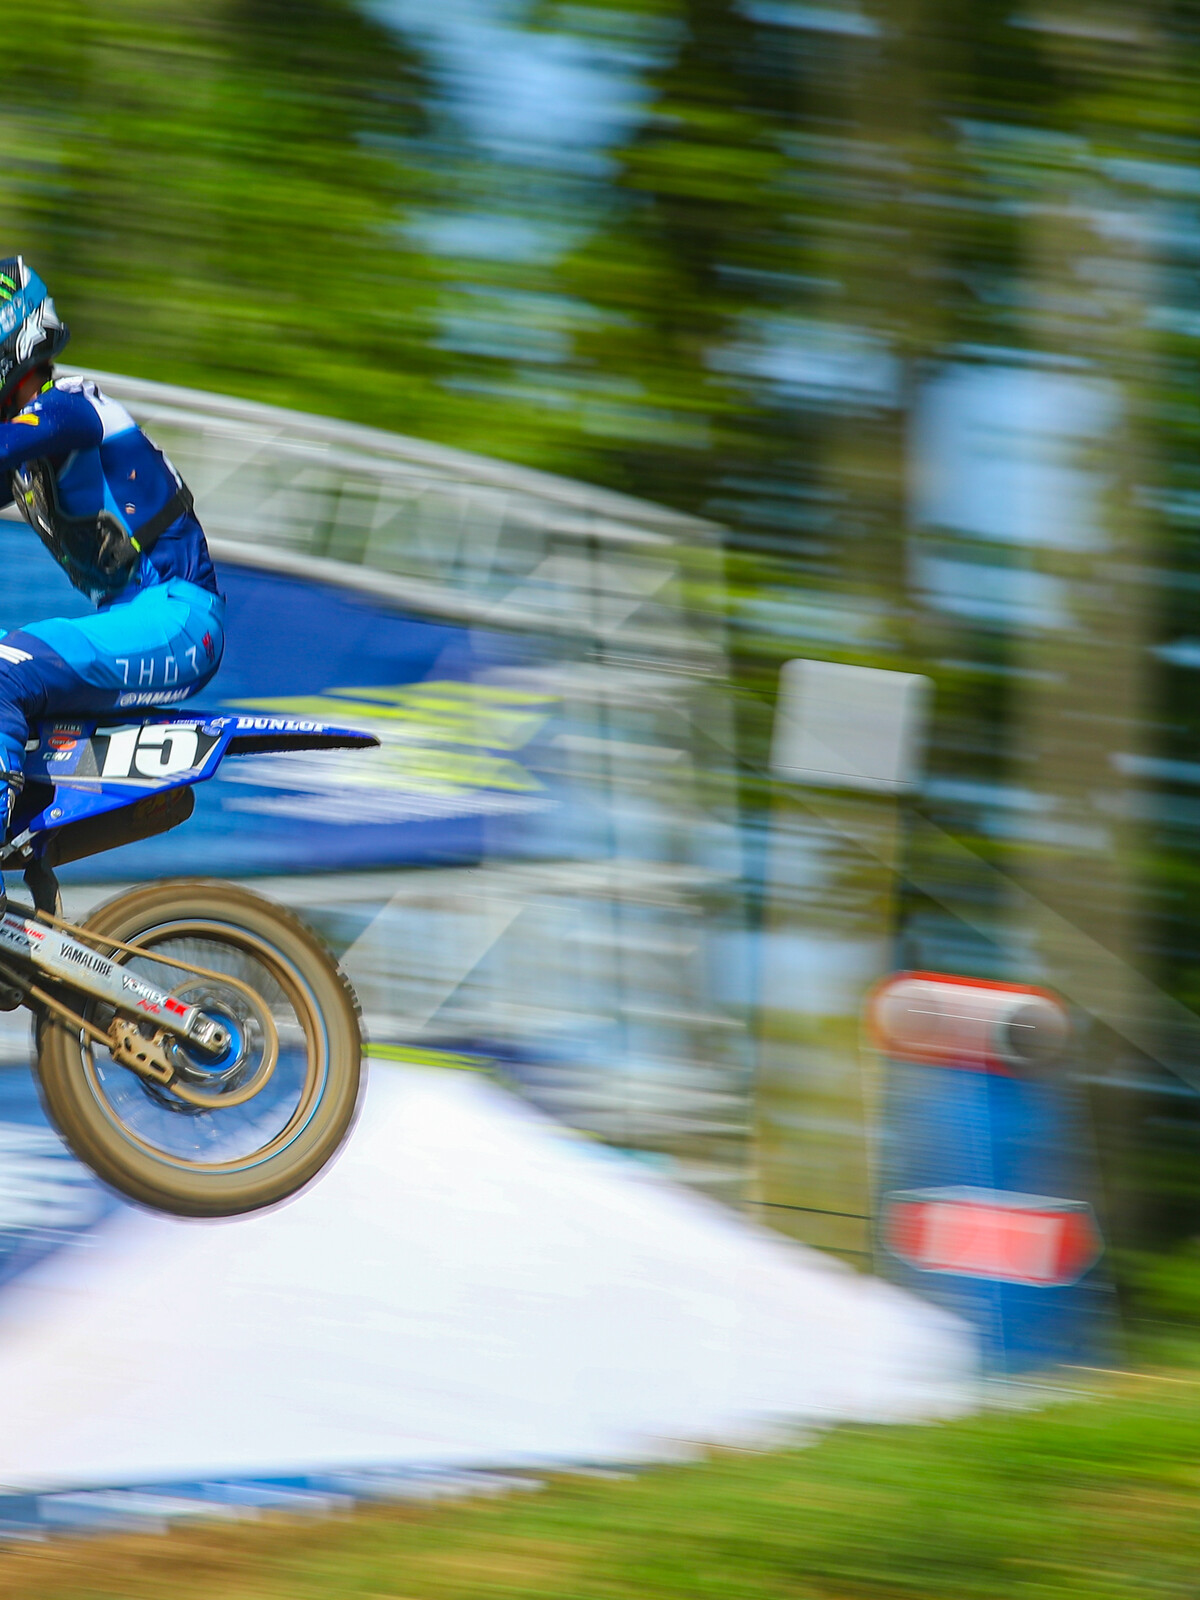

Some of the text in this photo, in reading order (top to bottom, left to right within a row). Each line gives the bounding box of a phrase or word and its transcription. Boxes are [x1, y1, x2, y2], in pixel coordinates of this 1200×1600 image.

[136, 686, 191, 706] YAMAHA
[236, 717, 330, 732] DUNLOP
[95, 723, 199, 778] 15
[60, 943, 114, 978] YAMALUBE
